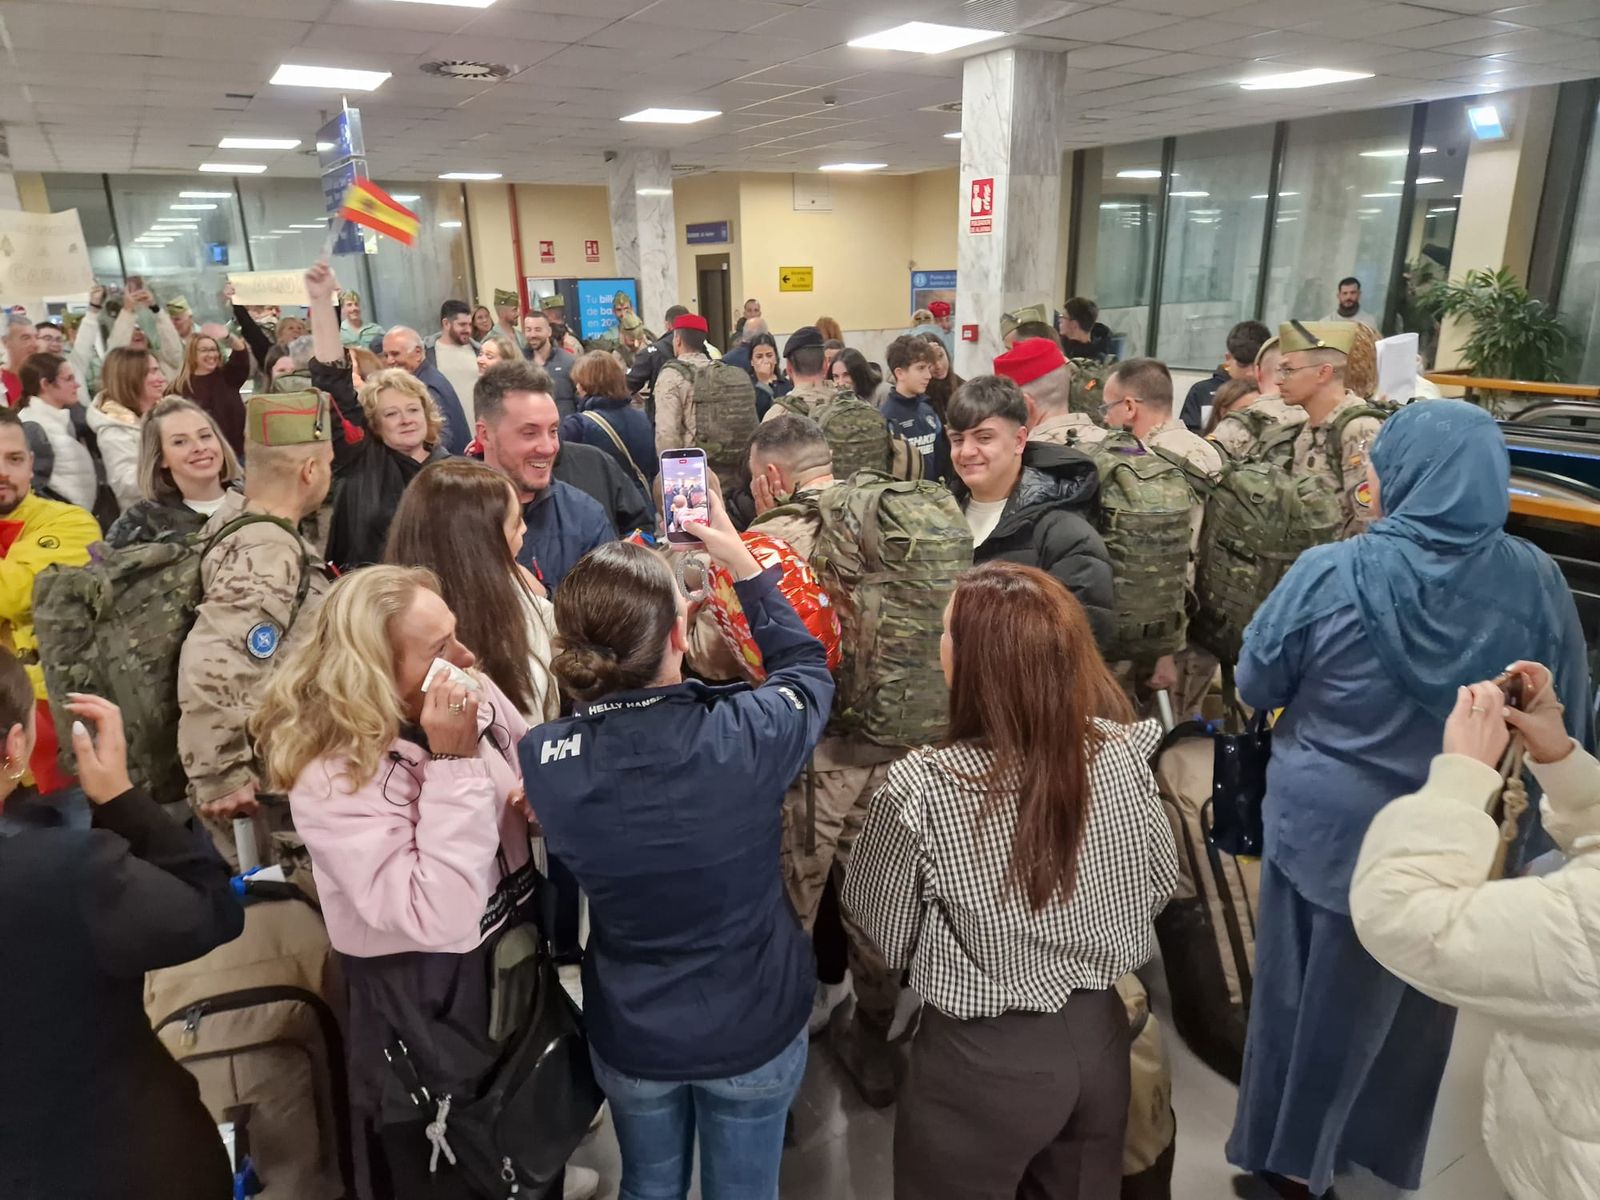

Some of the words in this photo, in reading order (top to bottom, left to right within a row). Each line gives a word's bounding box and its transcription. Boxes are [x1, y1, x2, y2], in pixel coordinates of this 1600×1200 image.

[585, 294, 598, 304] Tu
[586, 307, 599, 316] de
[587, 319, 599, 328] en
[588, 702, 623, 716] HELLY
[540, 733, 582, 765] HH
